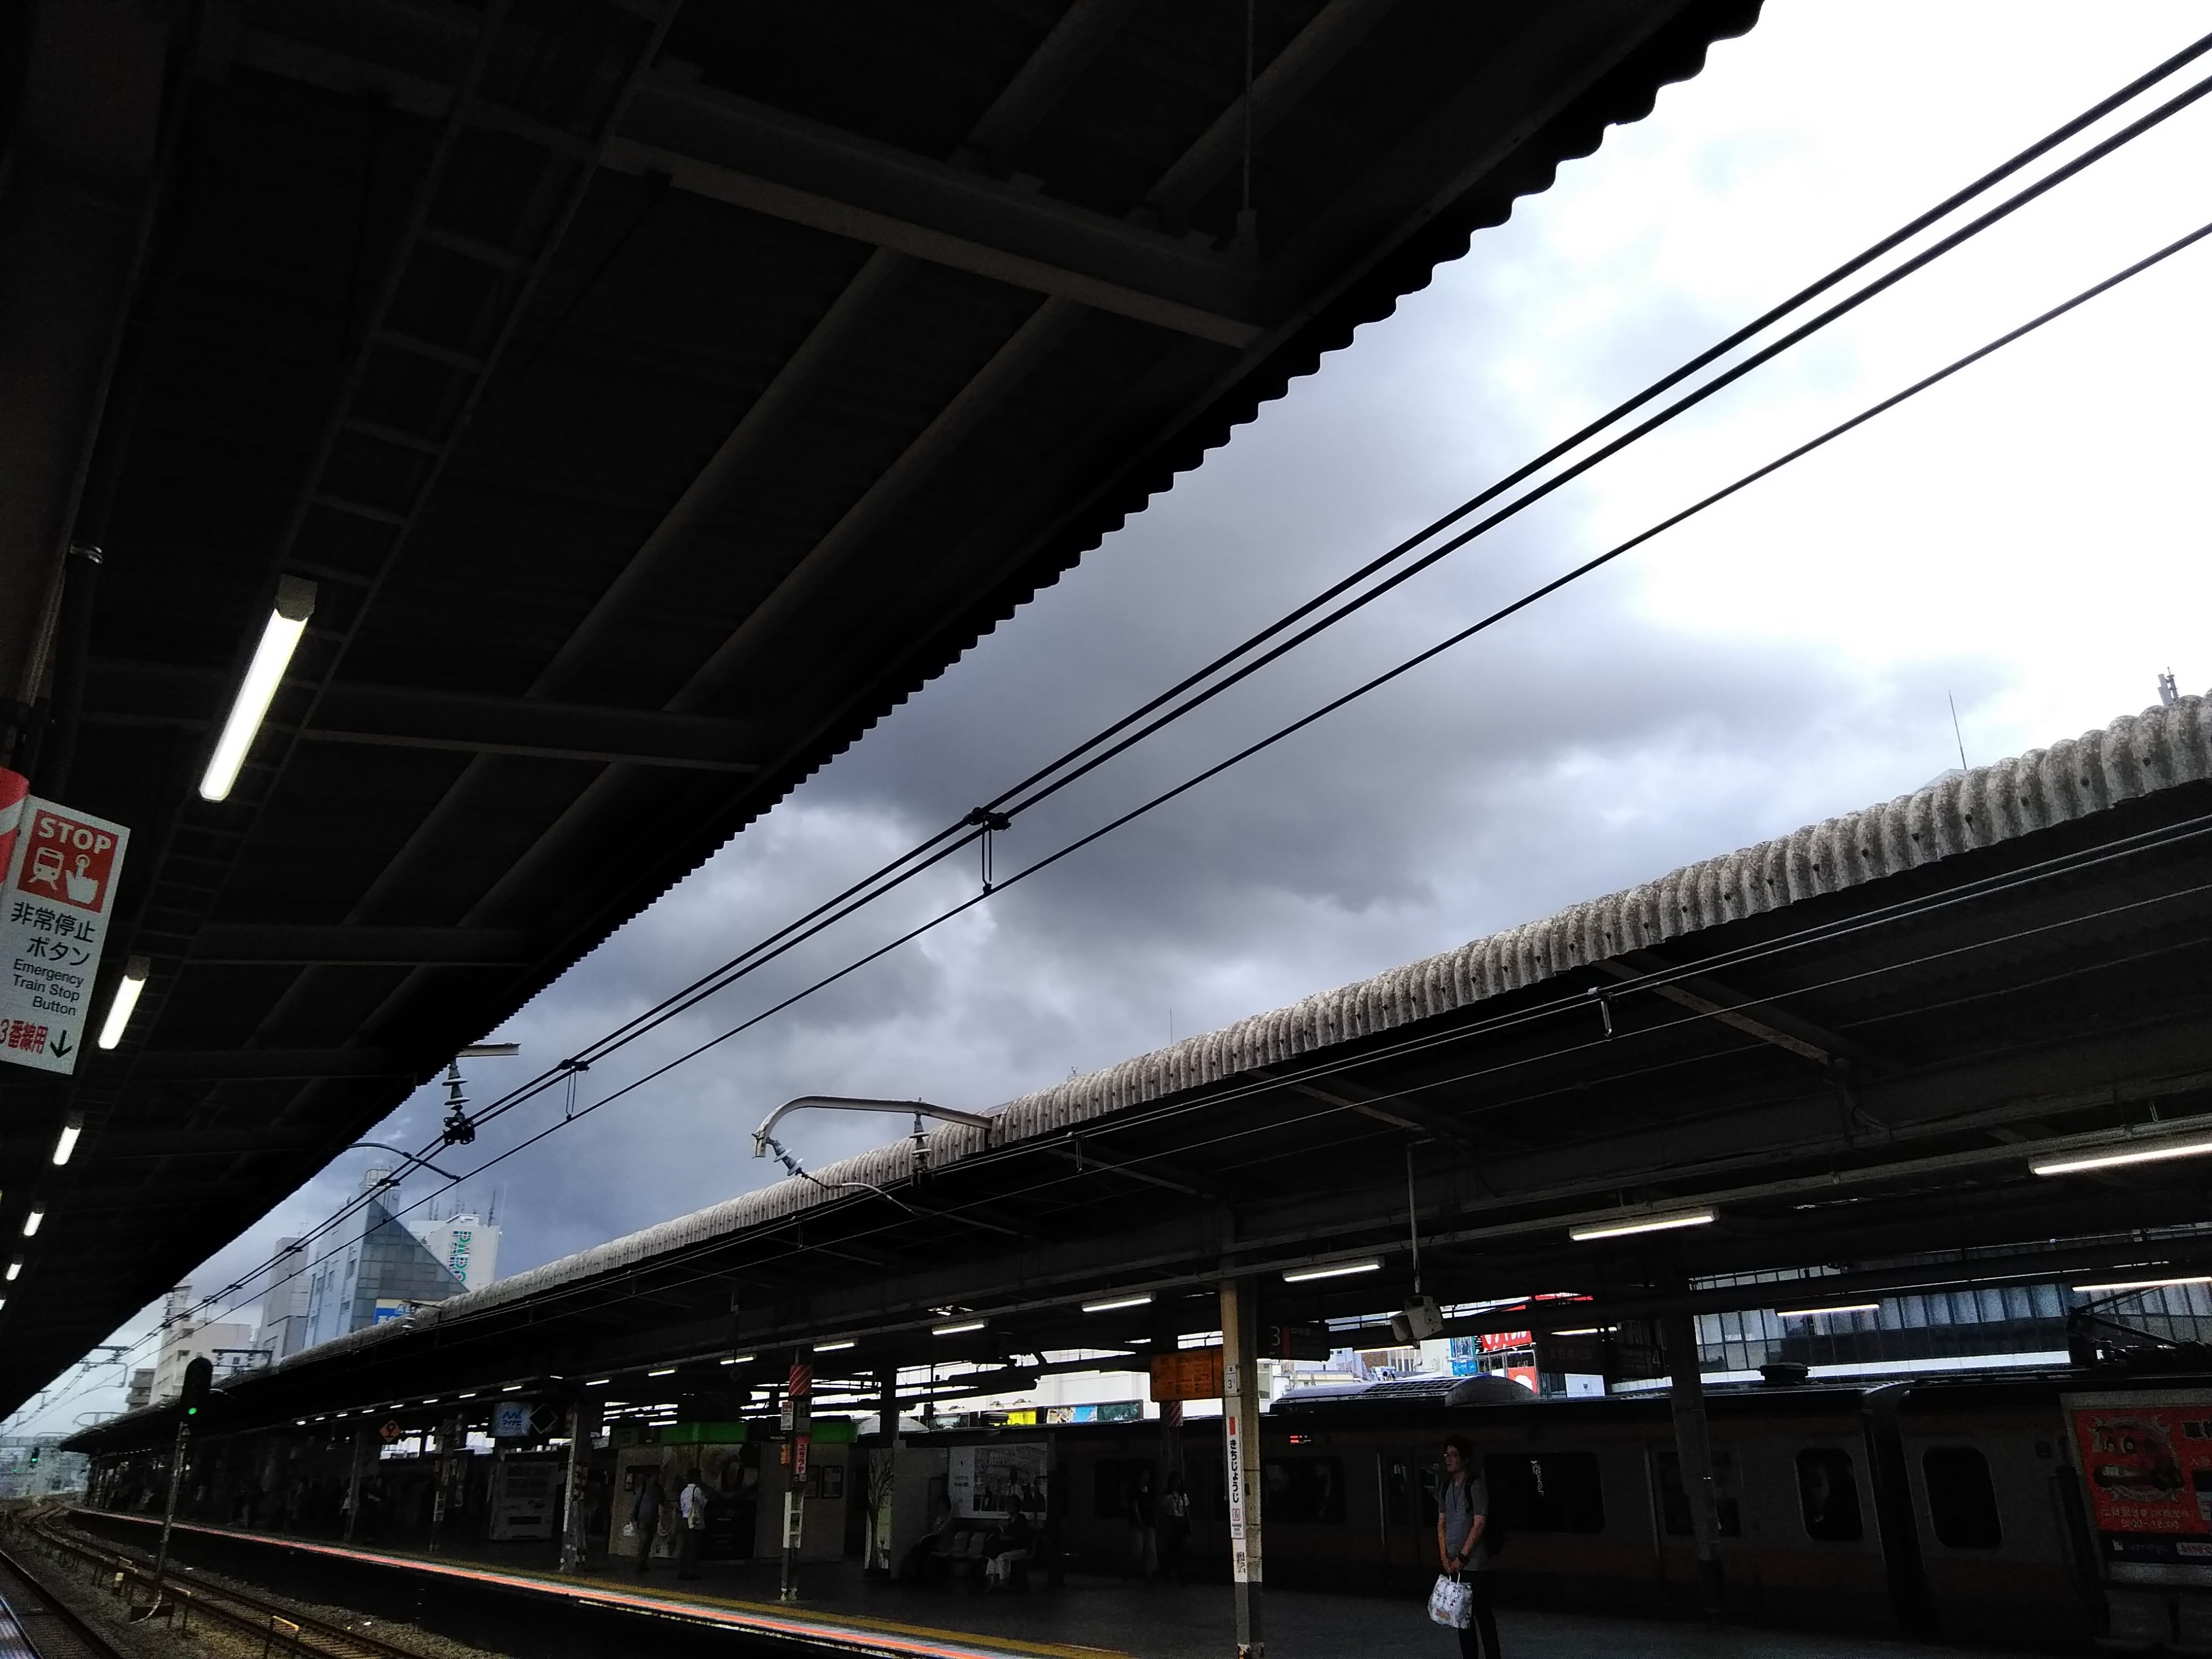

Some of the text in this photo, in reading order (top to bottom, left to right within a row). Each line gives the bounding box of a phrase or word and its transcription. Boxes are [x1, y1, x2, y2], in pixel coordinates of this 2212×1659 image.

[38, 817, 112, 854] STOP
[11, 901, 96, 943] 非常停止
[26, 936, 90, 967] ボタン
[13, 958, 85, 988] Emergency
[12, 974, 80, 1003] Train Stop
[32, 995, 76, 1016] Button
[448, 1231, 472, 1283] PARC
[1270, 1325, 1281, 1347] 3
[1652, 1350, 1661, 1368] 4
[1228, 1379, 1232, 1389] 3
[1229, 1439, 1240, 1503] きちじょうじ
